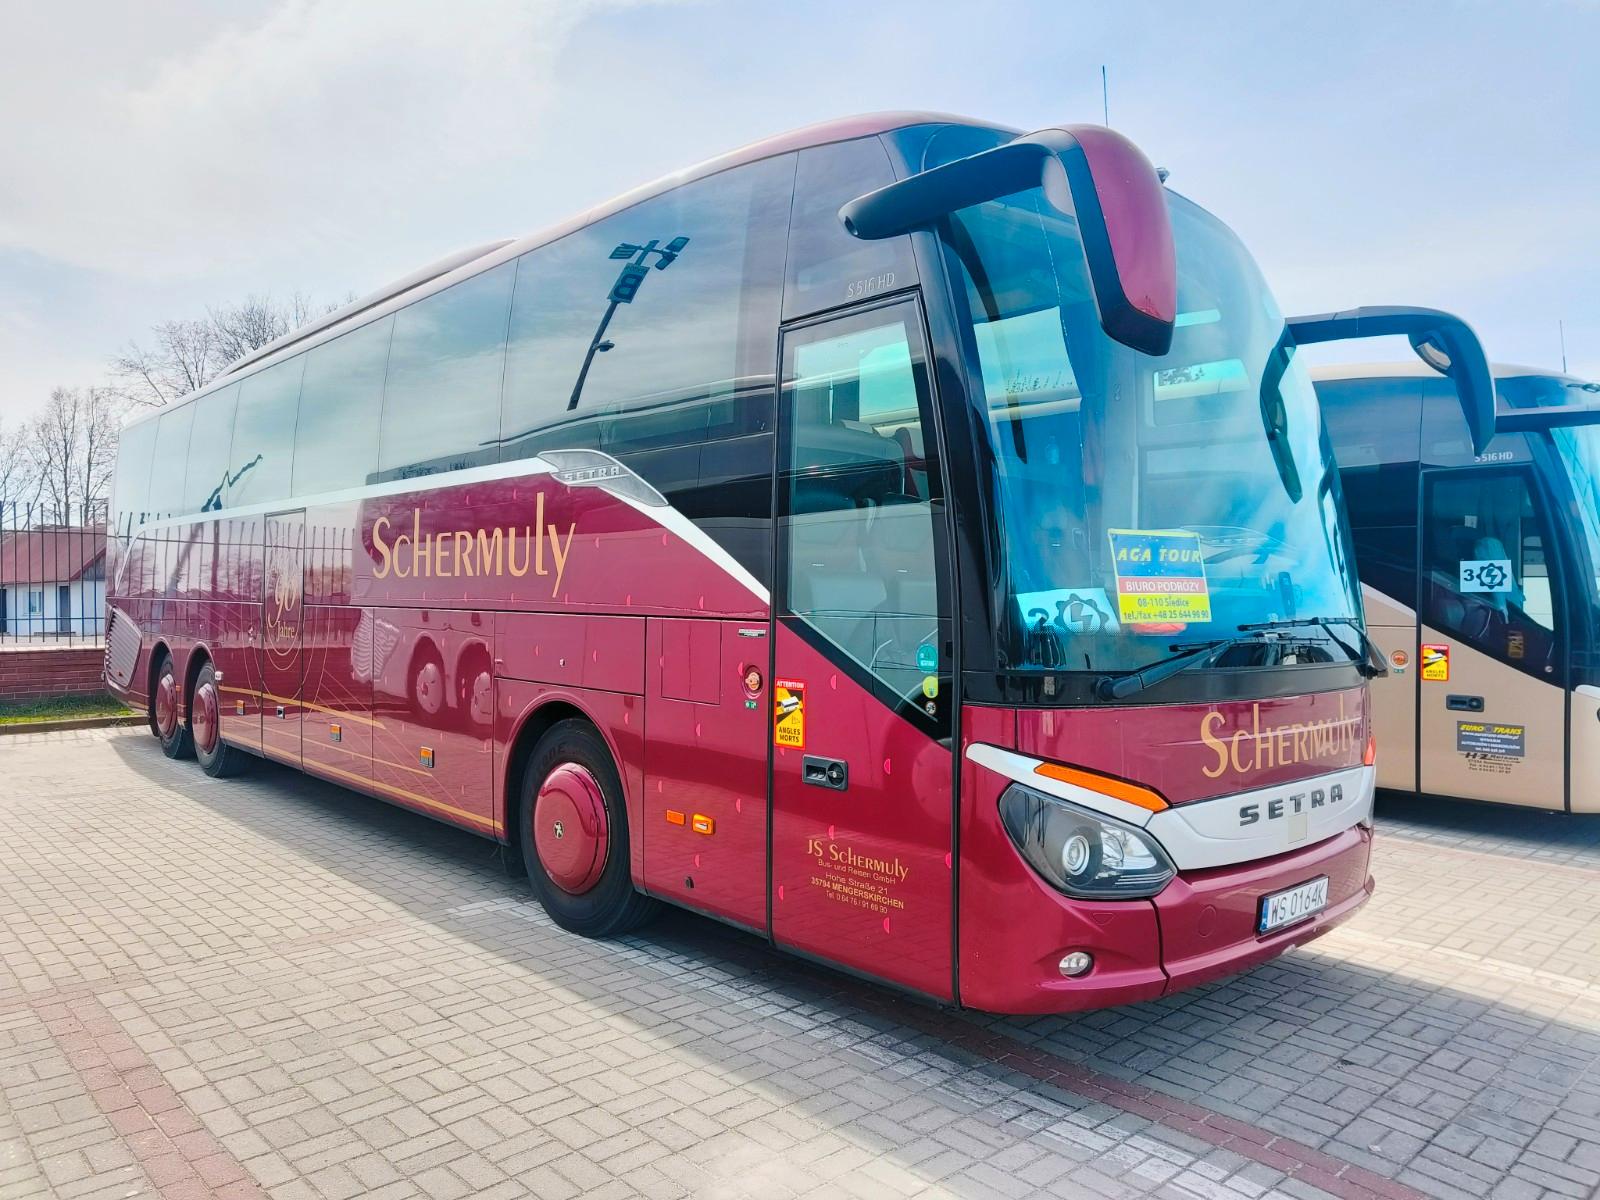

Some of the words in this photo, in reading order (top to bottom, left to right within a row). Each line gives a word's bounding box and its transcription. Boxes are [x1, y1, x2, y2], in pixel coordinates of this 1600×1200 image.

[847, 282, 854, 298] S
[878, 272, 895, 289] HD
[1482, 452, 1497, 462] 516
[1499, 451, 1513, 460] HD
[564, 466, 619, 481] SETRA
[1159, 548, 1201, 562] TOUR
[1464, 568, 1475, 581] 3
[1126, 581, 1156, 592] BIURO
[777, 680, 804, 689] ATTENTION
[778, 726, 800, 736] ANGLES
[779, 734, 800, 743] MORTS
[1239, 783, 1343, 827] SETRA
[808, 840, 823, 857] JS
[873, 873, 896, 885] GmbH
[849, 878, 876, 891] Straße
[878, 886, 888, 895] 21
[832, 882, 904, 909] MENGERSKIRCHEN
[1271, 897, 1287, 924] WS
[1291, 881, 1326, 916] 0164K
